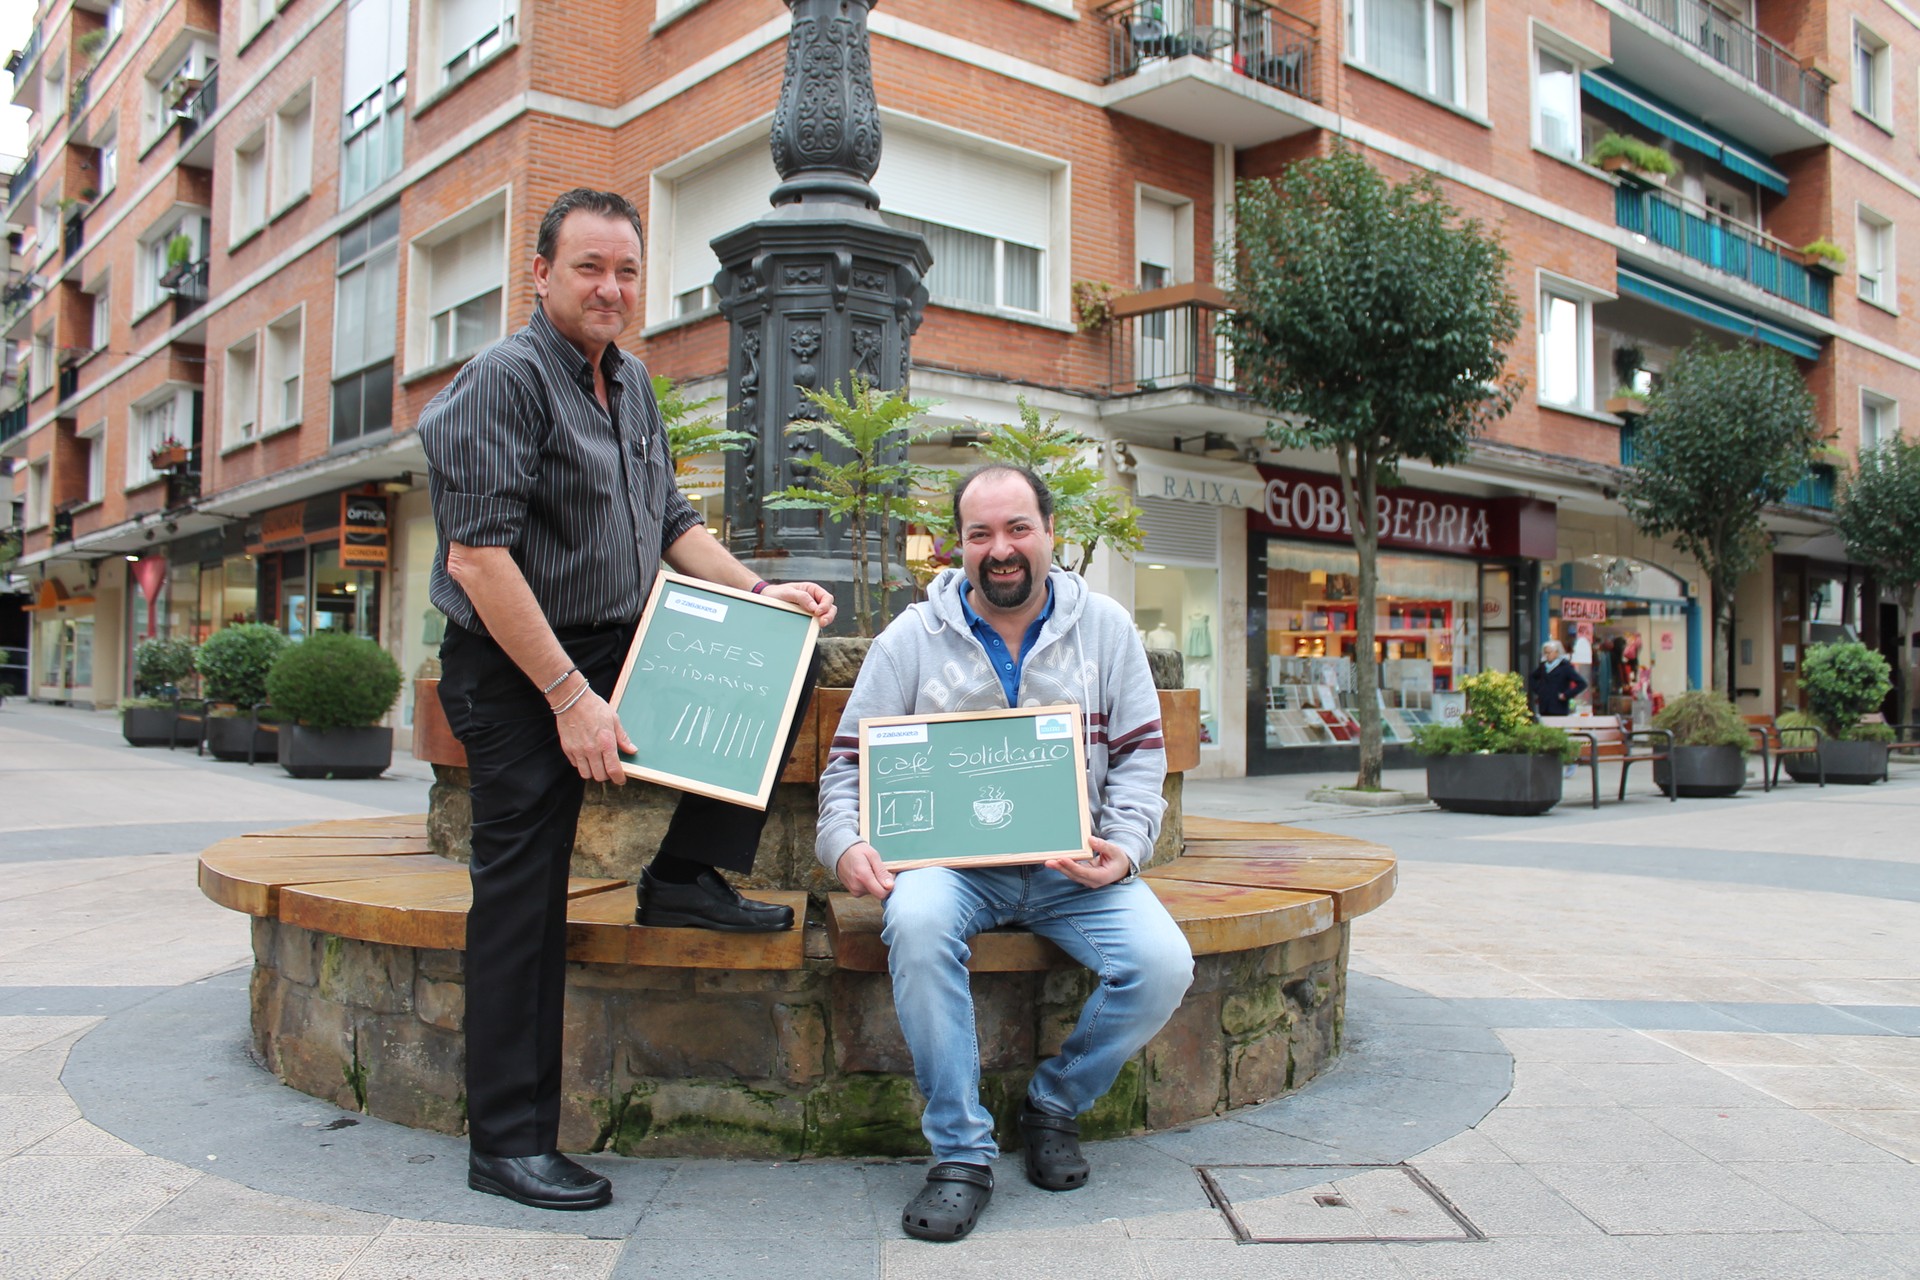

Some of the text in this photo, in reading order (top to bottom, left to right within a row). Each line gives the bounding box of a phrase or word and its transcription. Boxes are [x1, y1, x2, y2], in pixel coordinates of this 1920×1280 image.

[1164, 475, 1241, 505] RAIXA
[1563, 600, 1605, 620] REBAJAS
[666, 631, 766, 668] CAFES
[877, 736, 1069, 775] Café Solidario
